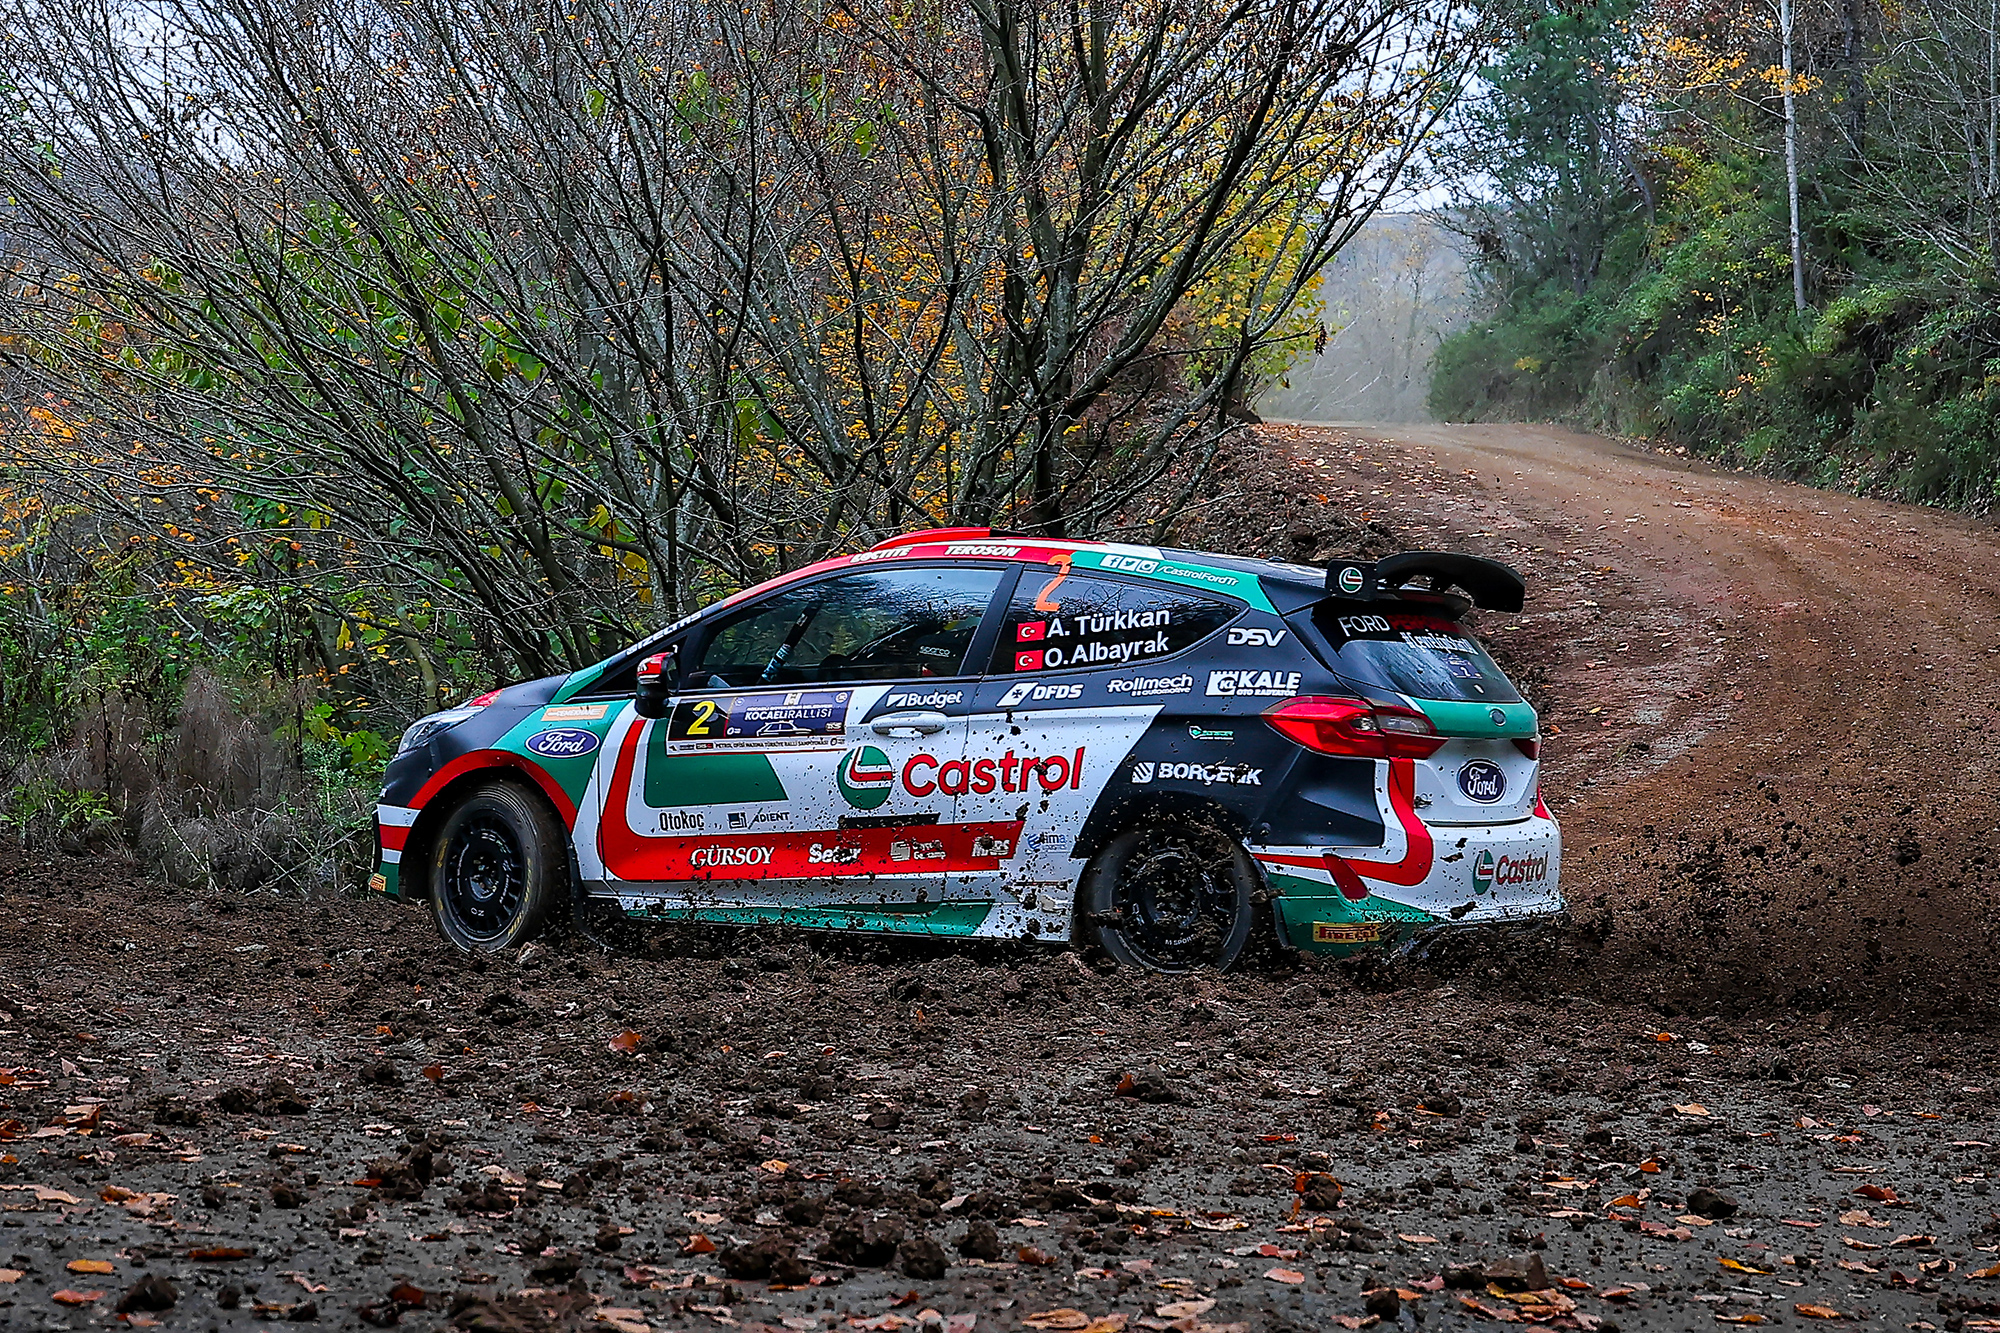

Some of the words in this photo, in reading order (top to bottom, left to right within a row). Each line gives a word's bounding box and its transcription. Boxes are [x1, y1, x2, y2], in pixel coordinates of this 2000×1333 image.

[850, 547, 913, 563] LOCTITE
[944, 546, 1021, 557] TEROSON
[1034, 554, 1073, 611] 2
[1047, 618, 1070, 638] A.
[1075, 609, 1170, 636] Türkkan
[1338, 615, 1390, 637] FORD
[1227, 627, 1287, 647] DSV
[1107, 674, 1193, 693] Rollmech
[1238, 671, 1302, 689] KALE
[906, 691, 964, 709] Budget
[1032, 684, 1085, 701] DFDS
[686, 700, 716, 735] 2
[538, 731, 587, 753] Ford
[902, 745, 1086, 797] Castrol
[1466, 766, 1499, 797] Ford
[660, 810, 705, 831] Otokoç
[752, 811, 790, 823] ADIENT
[690, 845, 775, 867] GÜRSOY
[1495, 850, 1549, 886] Castrol
